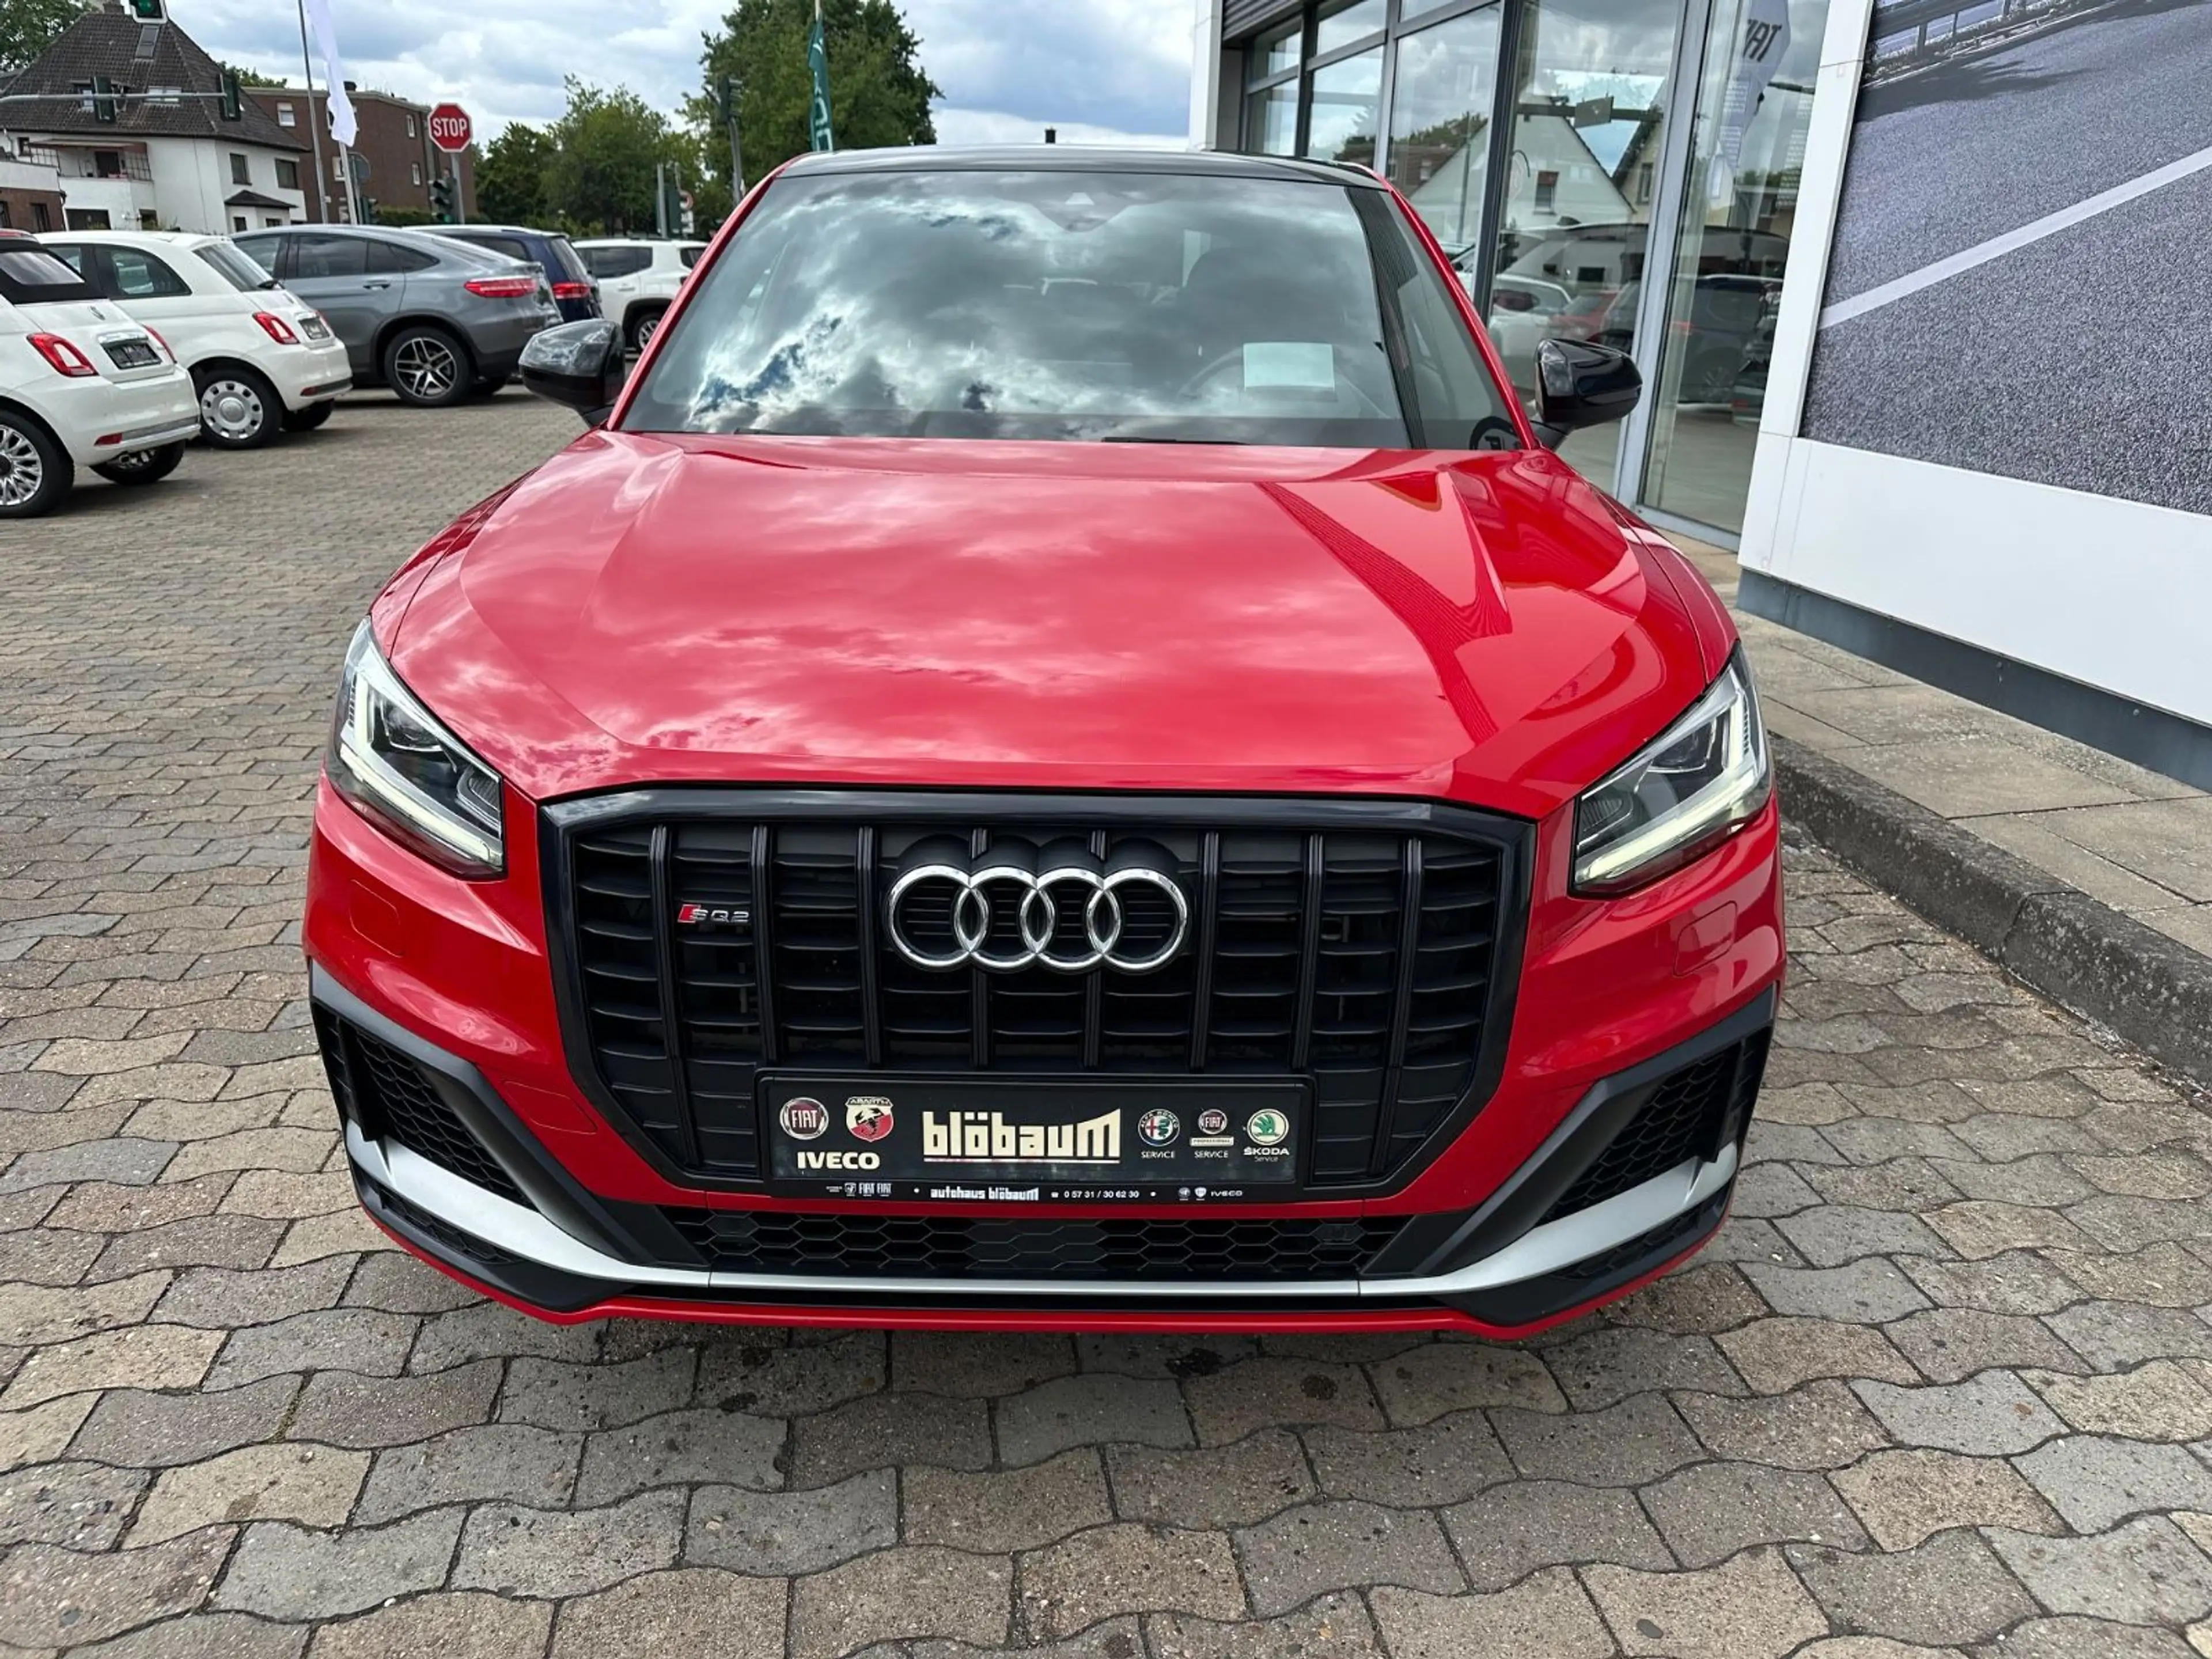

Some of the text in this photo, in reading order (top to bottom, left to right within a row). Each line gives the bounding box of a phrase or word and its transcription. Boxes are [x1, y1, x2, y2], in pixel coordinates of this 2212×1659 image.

[433, 118, 467, 137] STOP
[687, 907, 749, 923] SQ2
[791, 1109, 818, 1128] FIAT
[1205, 1117, 1221, 1127] FIAT
[922, 1108, 1120, 1157] blöbaum
[1141, 1150, 1175, 1159] SERVICE
[1194, 1150, 1229, 1158] SERVICE
[1243, 1146, 1290, 1156] ŠKODA
[797, 1152, 881, 1170] IVECO
[930, 1185, 1039, 1201] autohaus blöbaum
